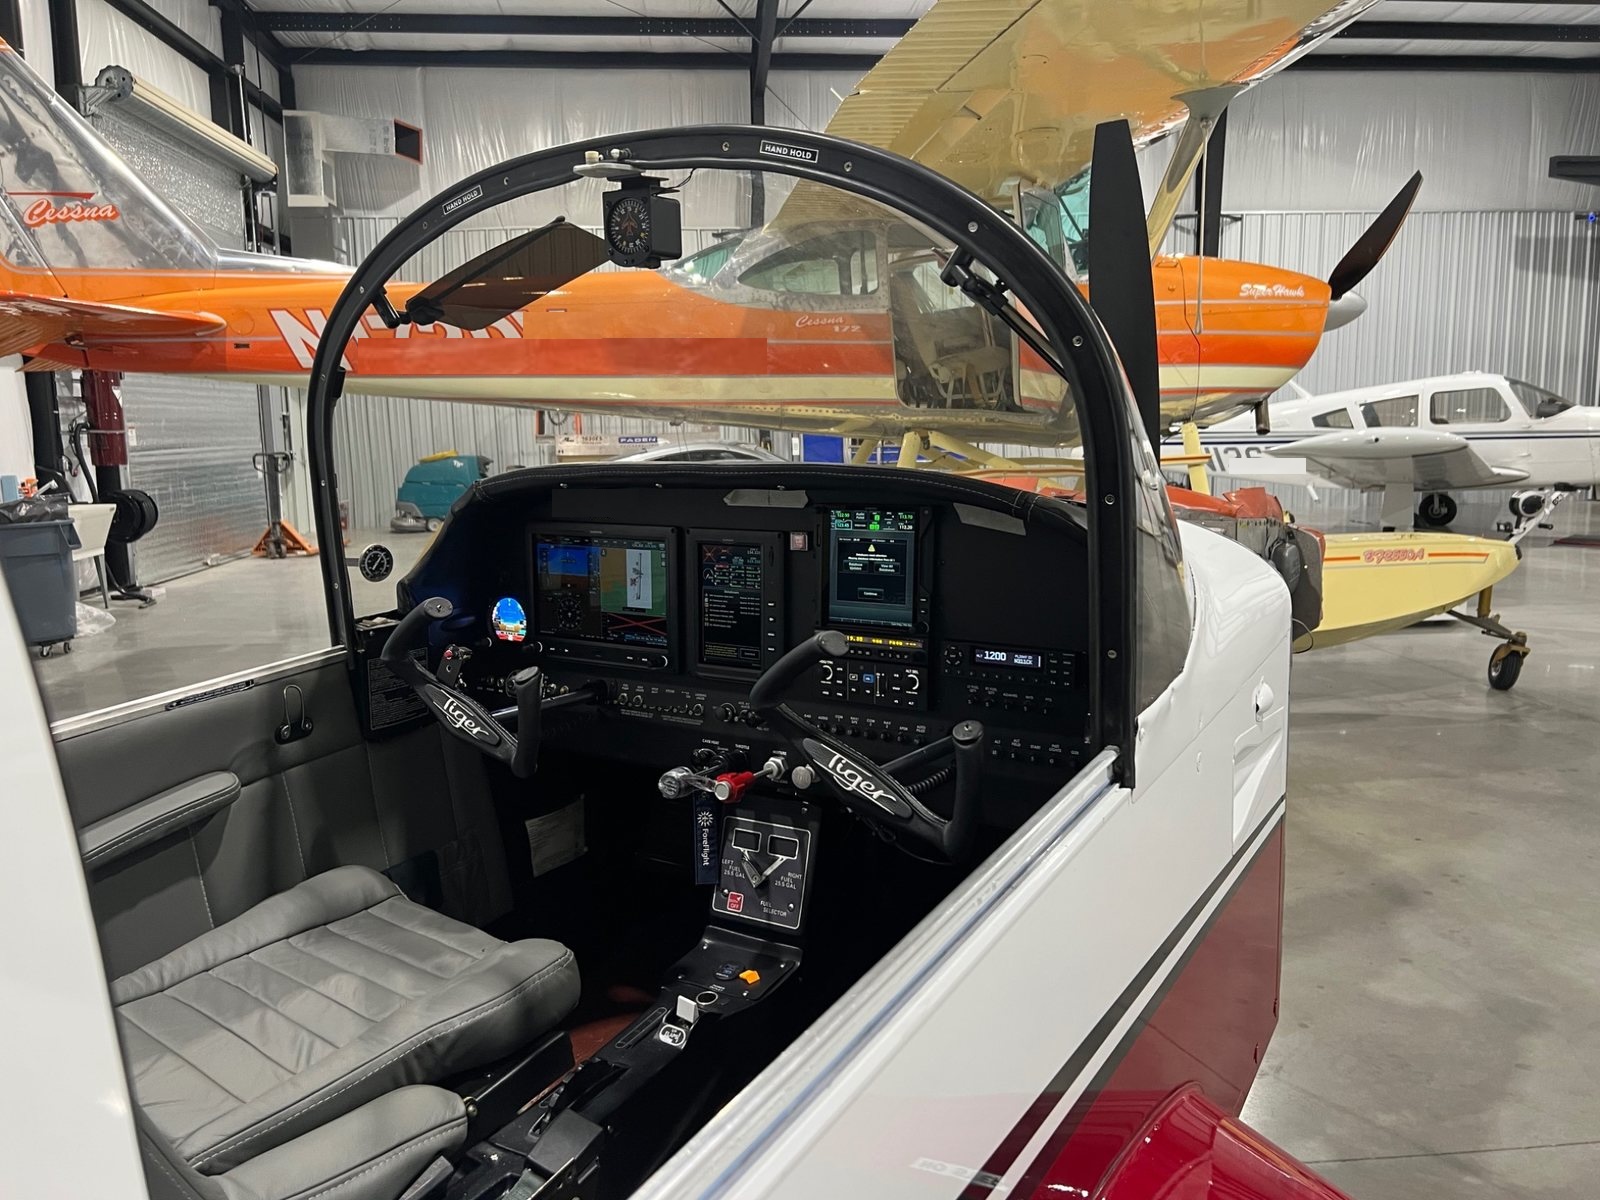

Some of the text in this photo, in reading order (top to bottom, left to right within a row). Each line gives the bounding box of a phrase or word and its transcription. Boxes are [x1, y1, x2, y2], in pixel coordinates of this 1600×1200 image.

[764, 144, 812, 159] HAND HOLD
[446, 190, 478, 211] HAND HOLD
[23, 199, 120, 228] Cessna
[795, 315, 844, 328] Cessna
[984, 650, 1006, 661] 1200
[443, 698, 489, 735] Tiger
[828, 754, 896, 801] Tiger
[701, 828, 710, 866] ForeFlight
[729, 864, 741, 872] FUEL
[760, 900, 772, 908] FUEL
[763, 907, 787, 917] SELECTOR
